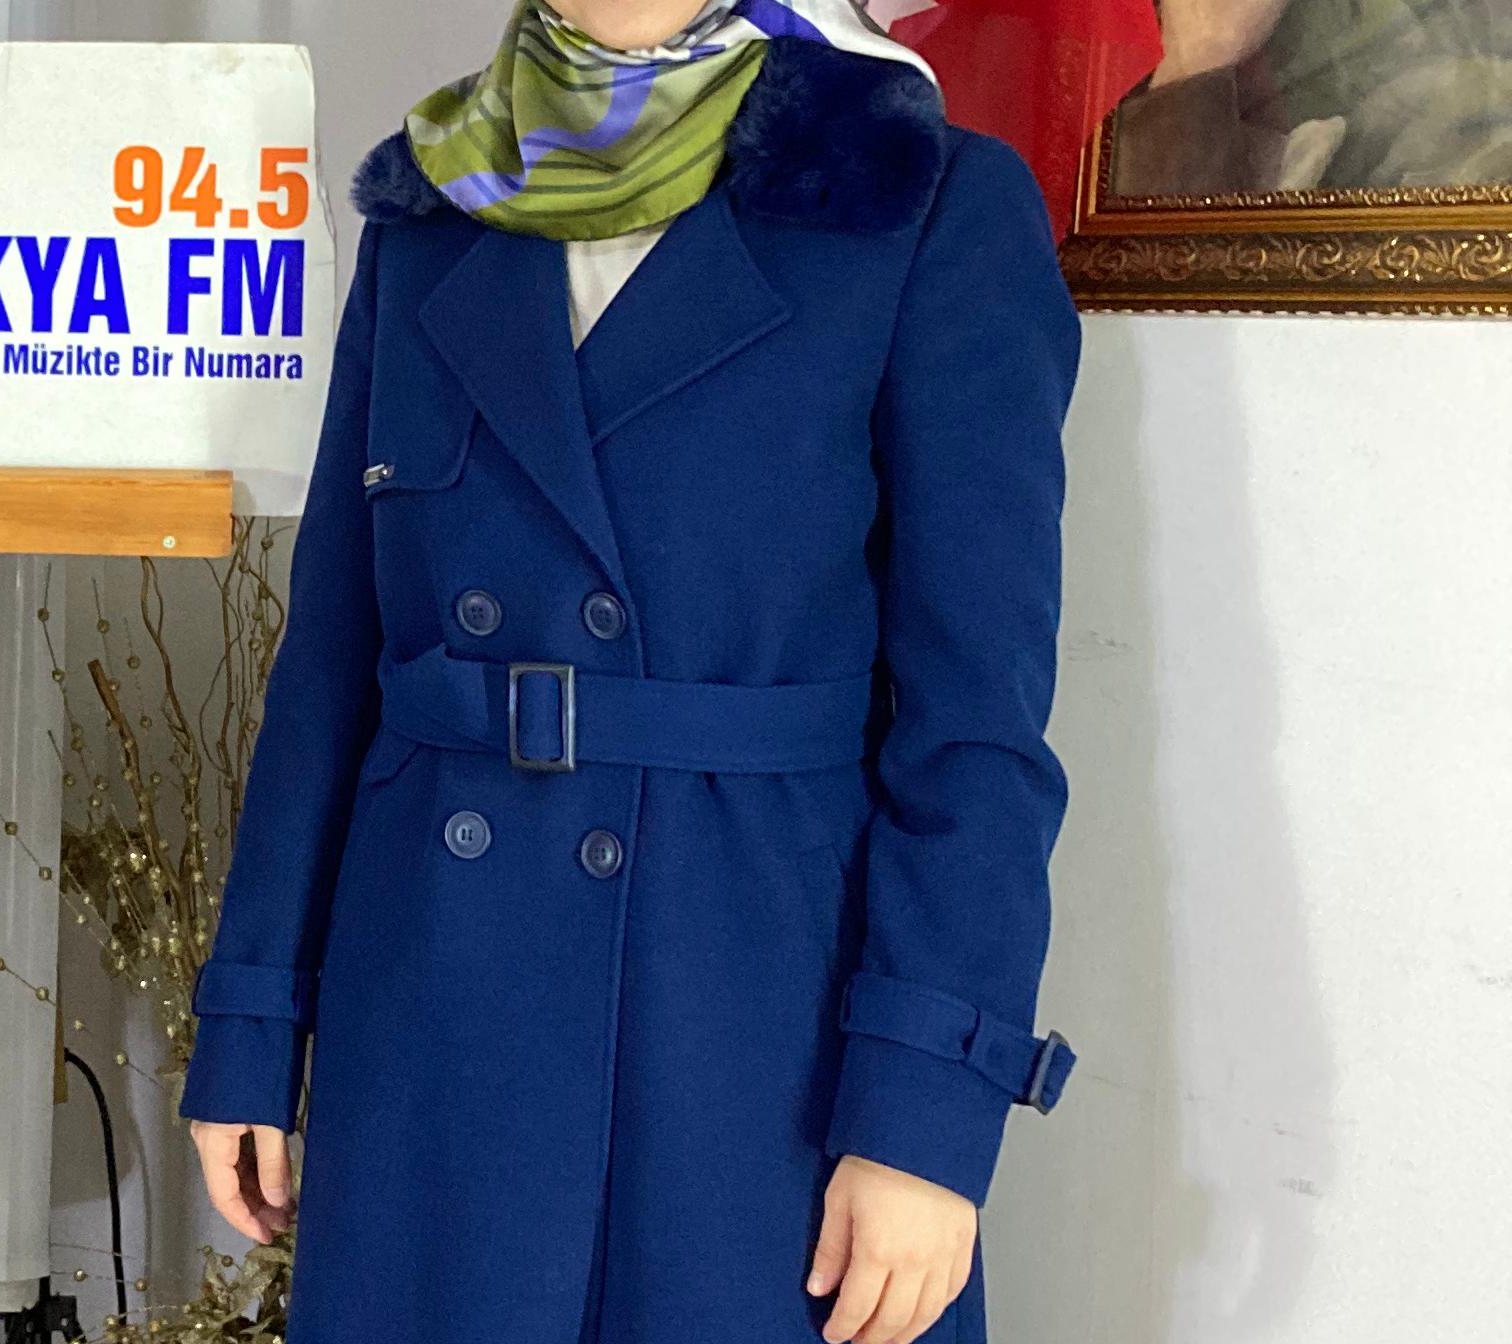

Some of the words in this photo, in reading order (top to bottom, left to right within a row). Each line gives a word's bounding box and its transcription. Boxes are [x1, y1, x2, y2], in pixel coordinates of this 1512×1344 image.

[112, 145, 310, 231] 94.5
[166, 237, 306, 338] FM
[3, 342, 121, 377] Müzikte
[131, 345, 174, 377] Bir
[184, 346, 304, 379] Numara
